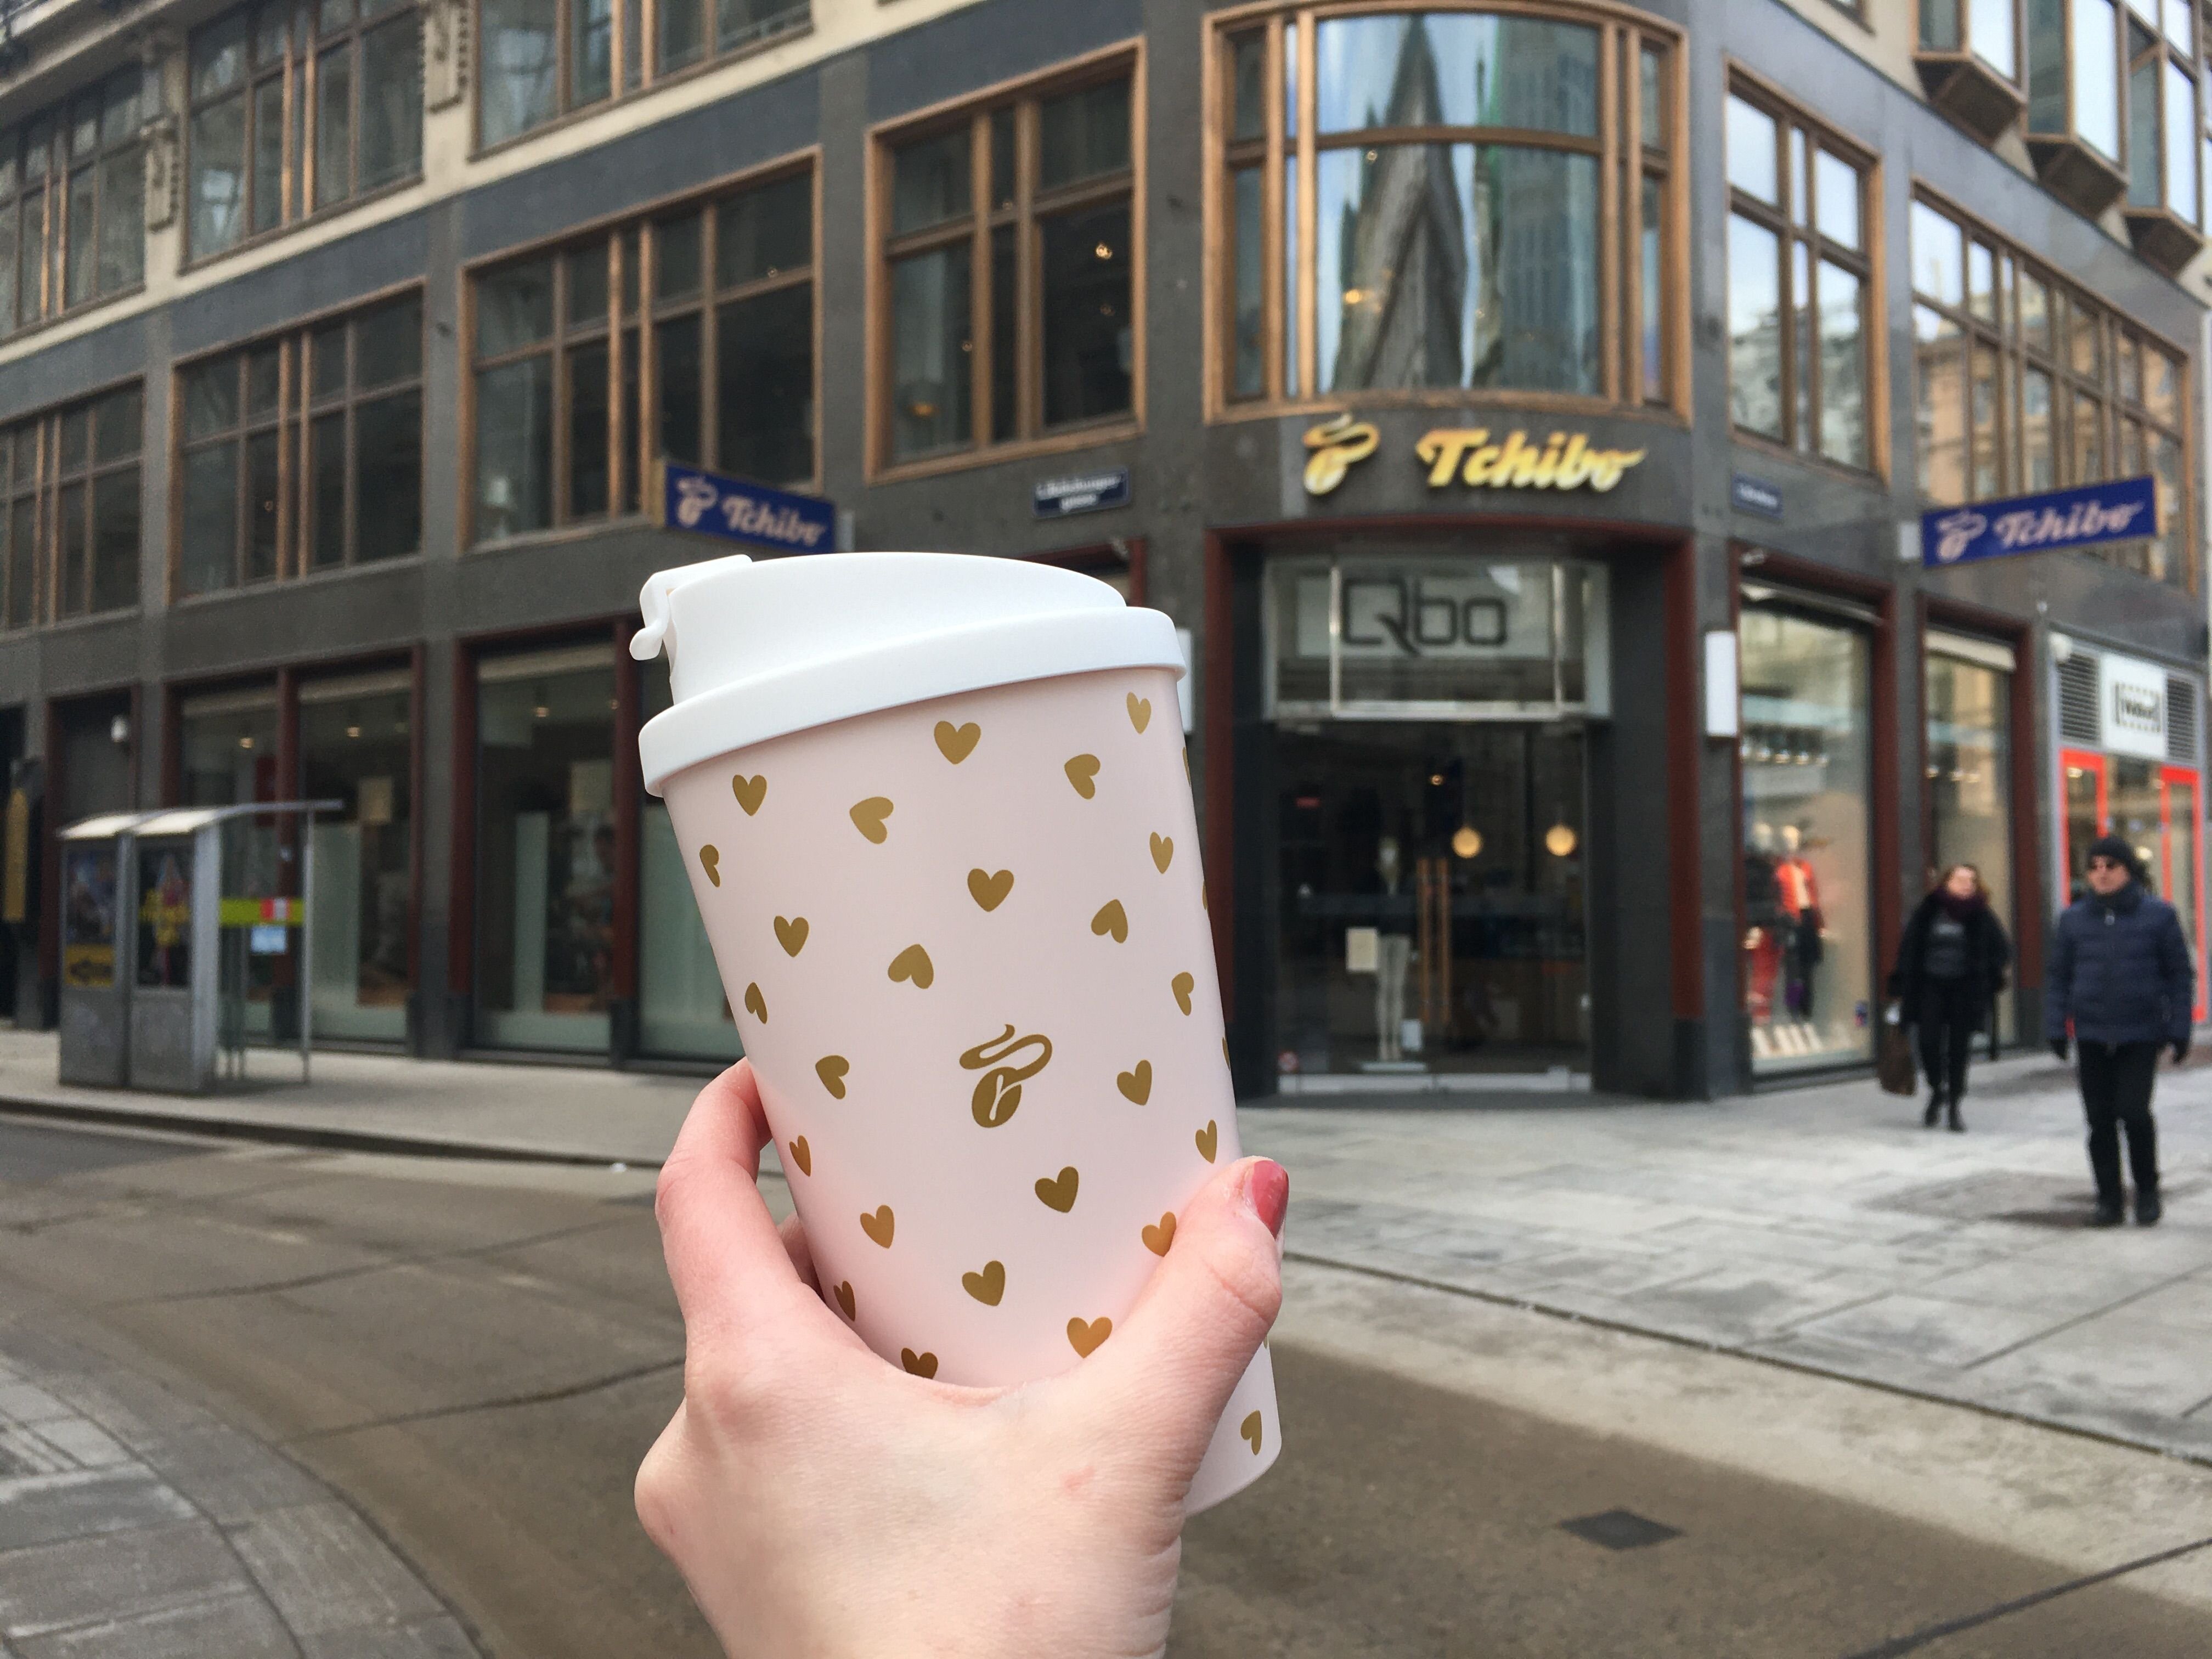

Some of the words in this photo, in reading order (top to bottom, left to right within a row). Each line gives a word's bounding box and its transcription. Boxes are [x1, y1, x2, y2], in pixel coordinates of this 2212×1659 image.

[1416, 427, 1646, 492] Tchibo
[721, 495, 825, 546] Tchibo
[1993, 500, 2144, 549] Tchibo
[1342, 576, 1507, 654] Qbo
